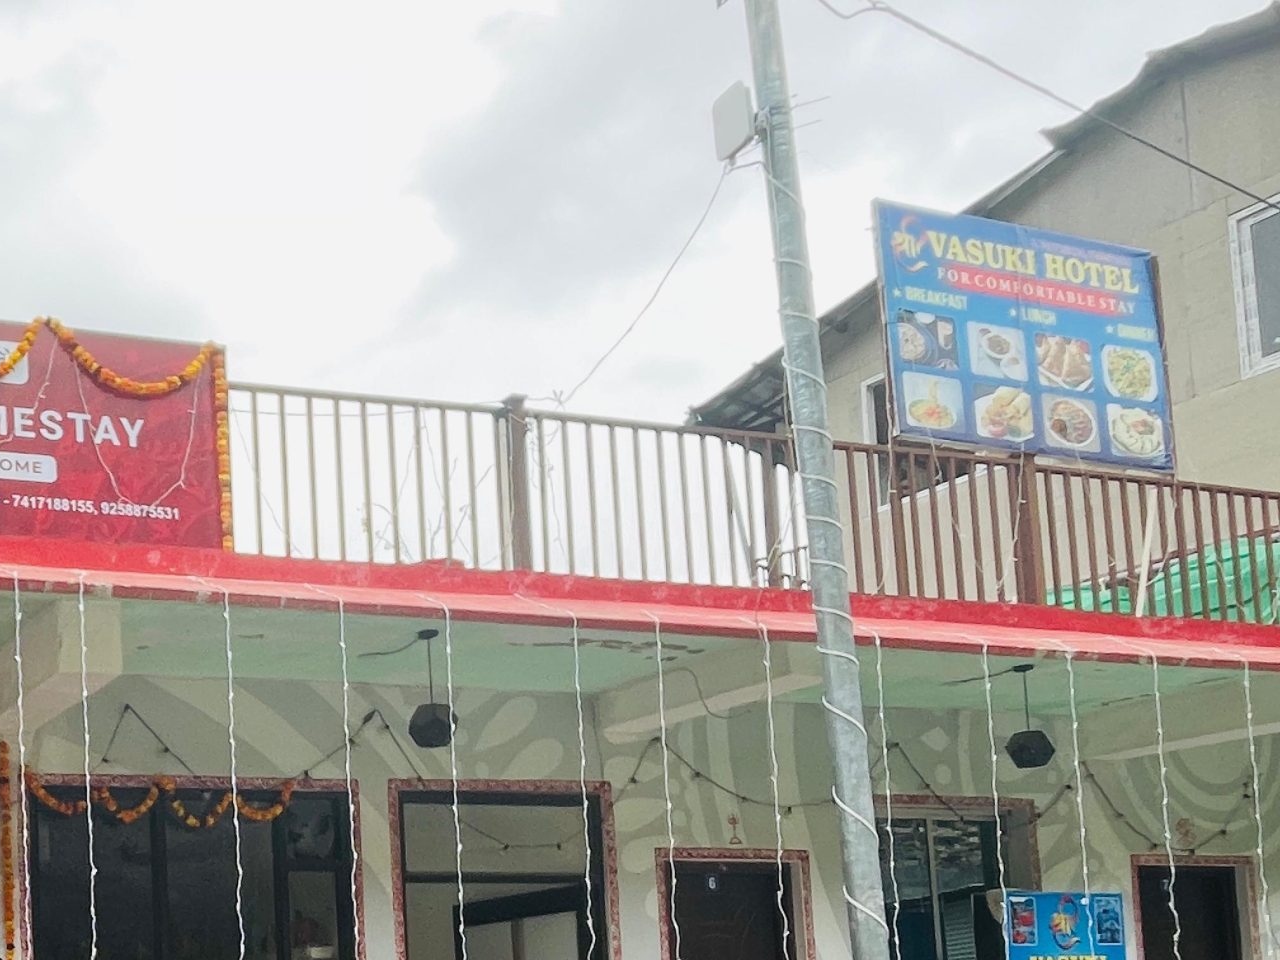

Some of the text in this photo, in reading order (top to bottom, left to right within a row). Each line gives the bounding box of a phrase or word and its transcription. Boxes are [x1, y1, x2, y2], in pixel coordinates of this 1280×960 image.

[926, 230, 1036, 275] VASUKI
[1044, 252, 1139, 294] HOTEL
[937, 266, 1136, 314] FOR COMFORTABLE STAY
[708, 876, 717, 890] 6
